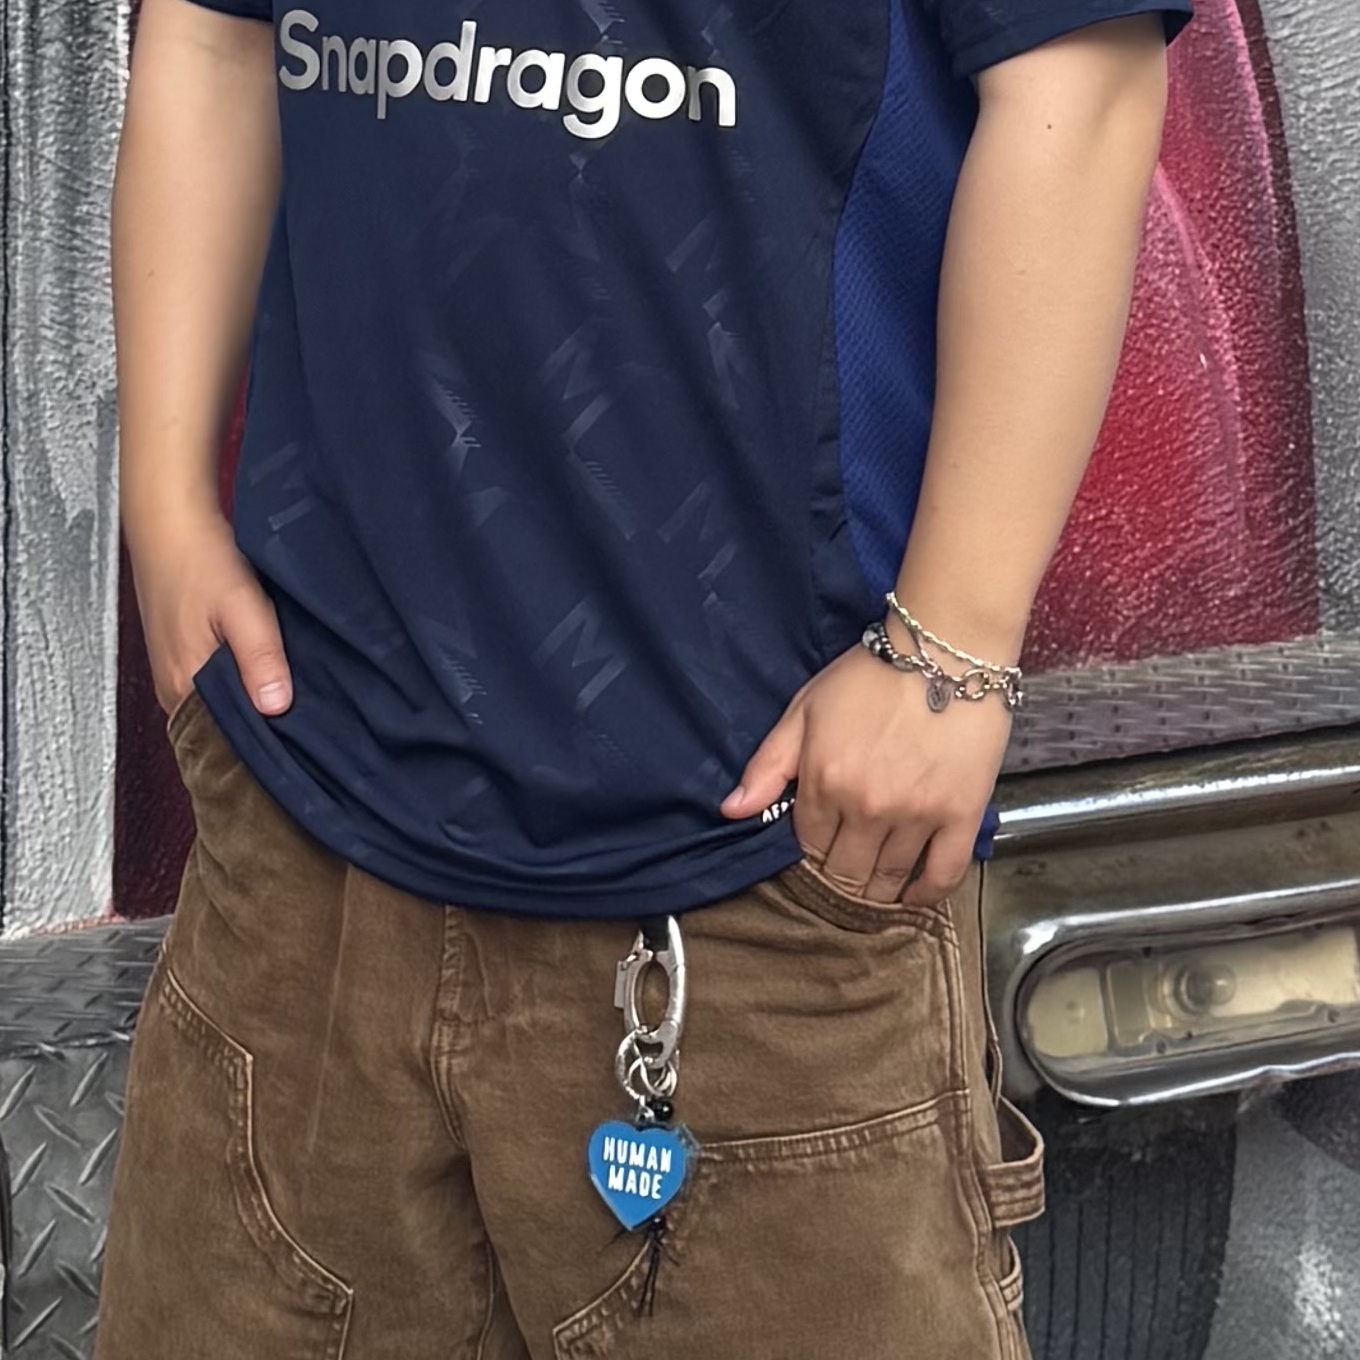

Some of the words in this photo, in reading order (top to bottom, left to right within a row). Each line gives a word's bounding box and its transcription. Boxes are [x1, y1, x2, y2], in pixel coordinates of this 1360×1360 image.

[278, 8, 737, 140] Snapdragon
[603, 1136, 672, 1173] HUMAN
[607, 1164, 663, 1199] MADE
